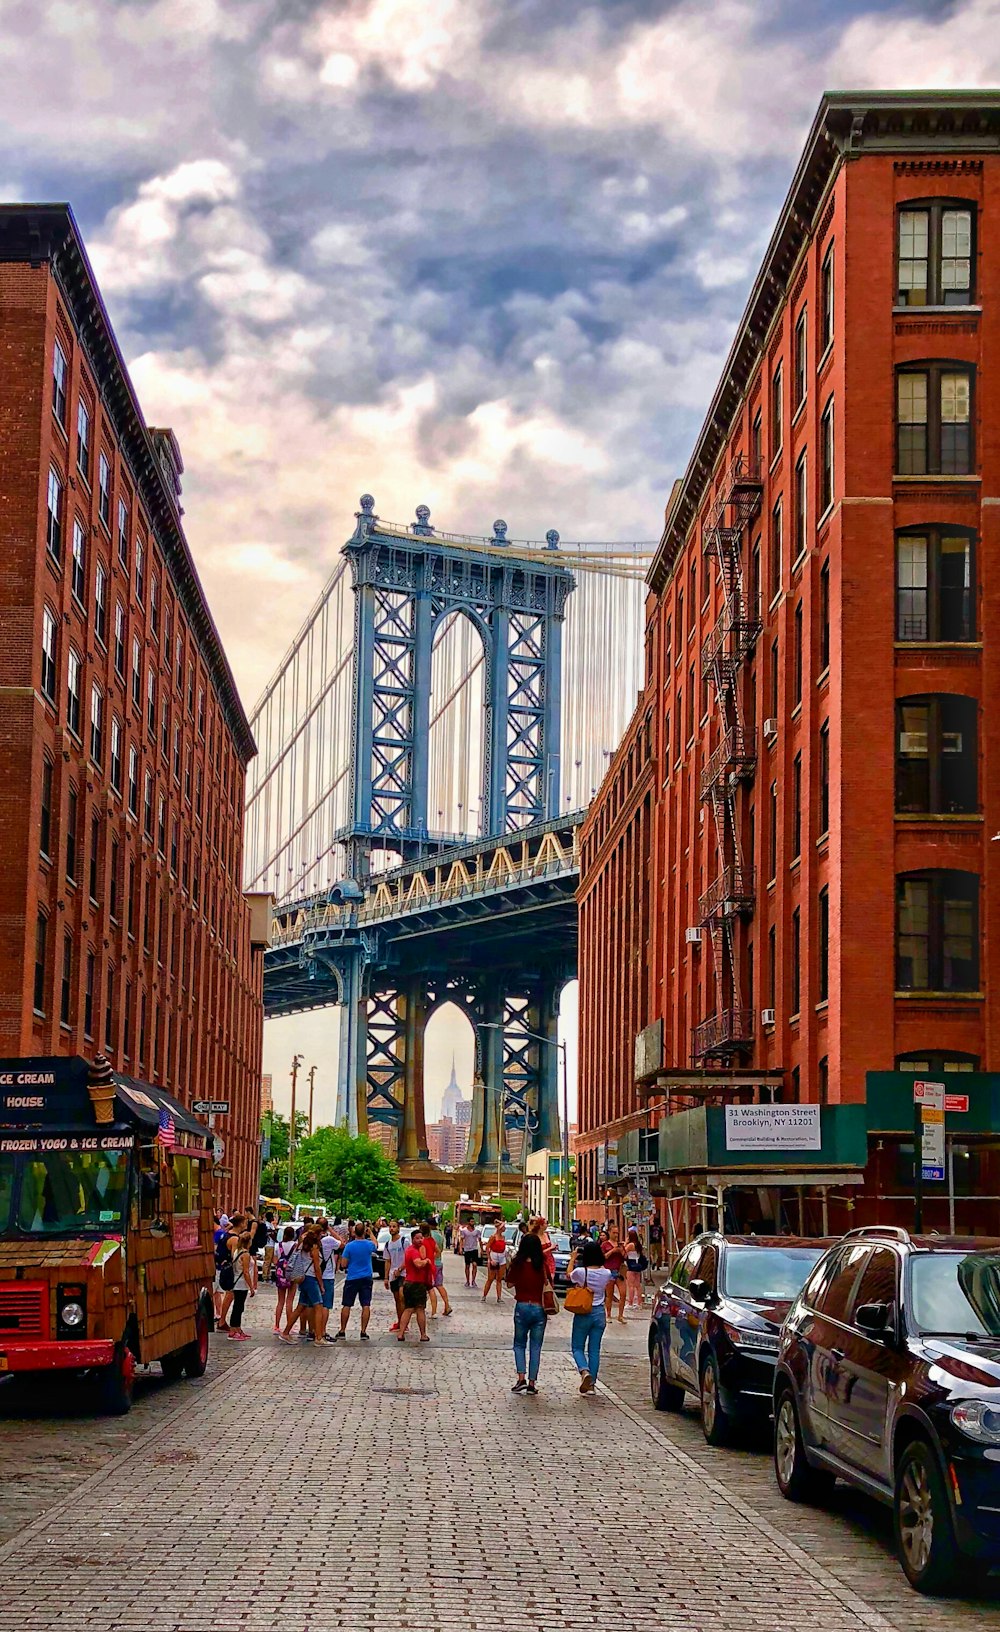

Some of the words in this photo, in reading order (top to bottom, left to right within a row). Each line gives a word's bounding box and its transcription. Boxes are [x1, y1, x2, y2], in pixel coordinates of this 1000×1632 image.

[0, 1074, 13, 1084] CE
[17, 1073, 54, 1084] CREAM
[7, 1097, 44, 1107] HOUSE
[729, 1109, 739, 1117] 31
[741, 1109, 790, 1117] Washington
[1, 1140, 37, 1150] FROZEN
[40, 1139, 67, 1149] YOGO
[70, 1139, 79, 1148] &
[81, 1138, 98, 1148] ICE
[100, 1137, 133, 1148] CREAM
